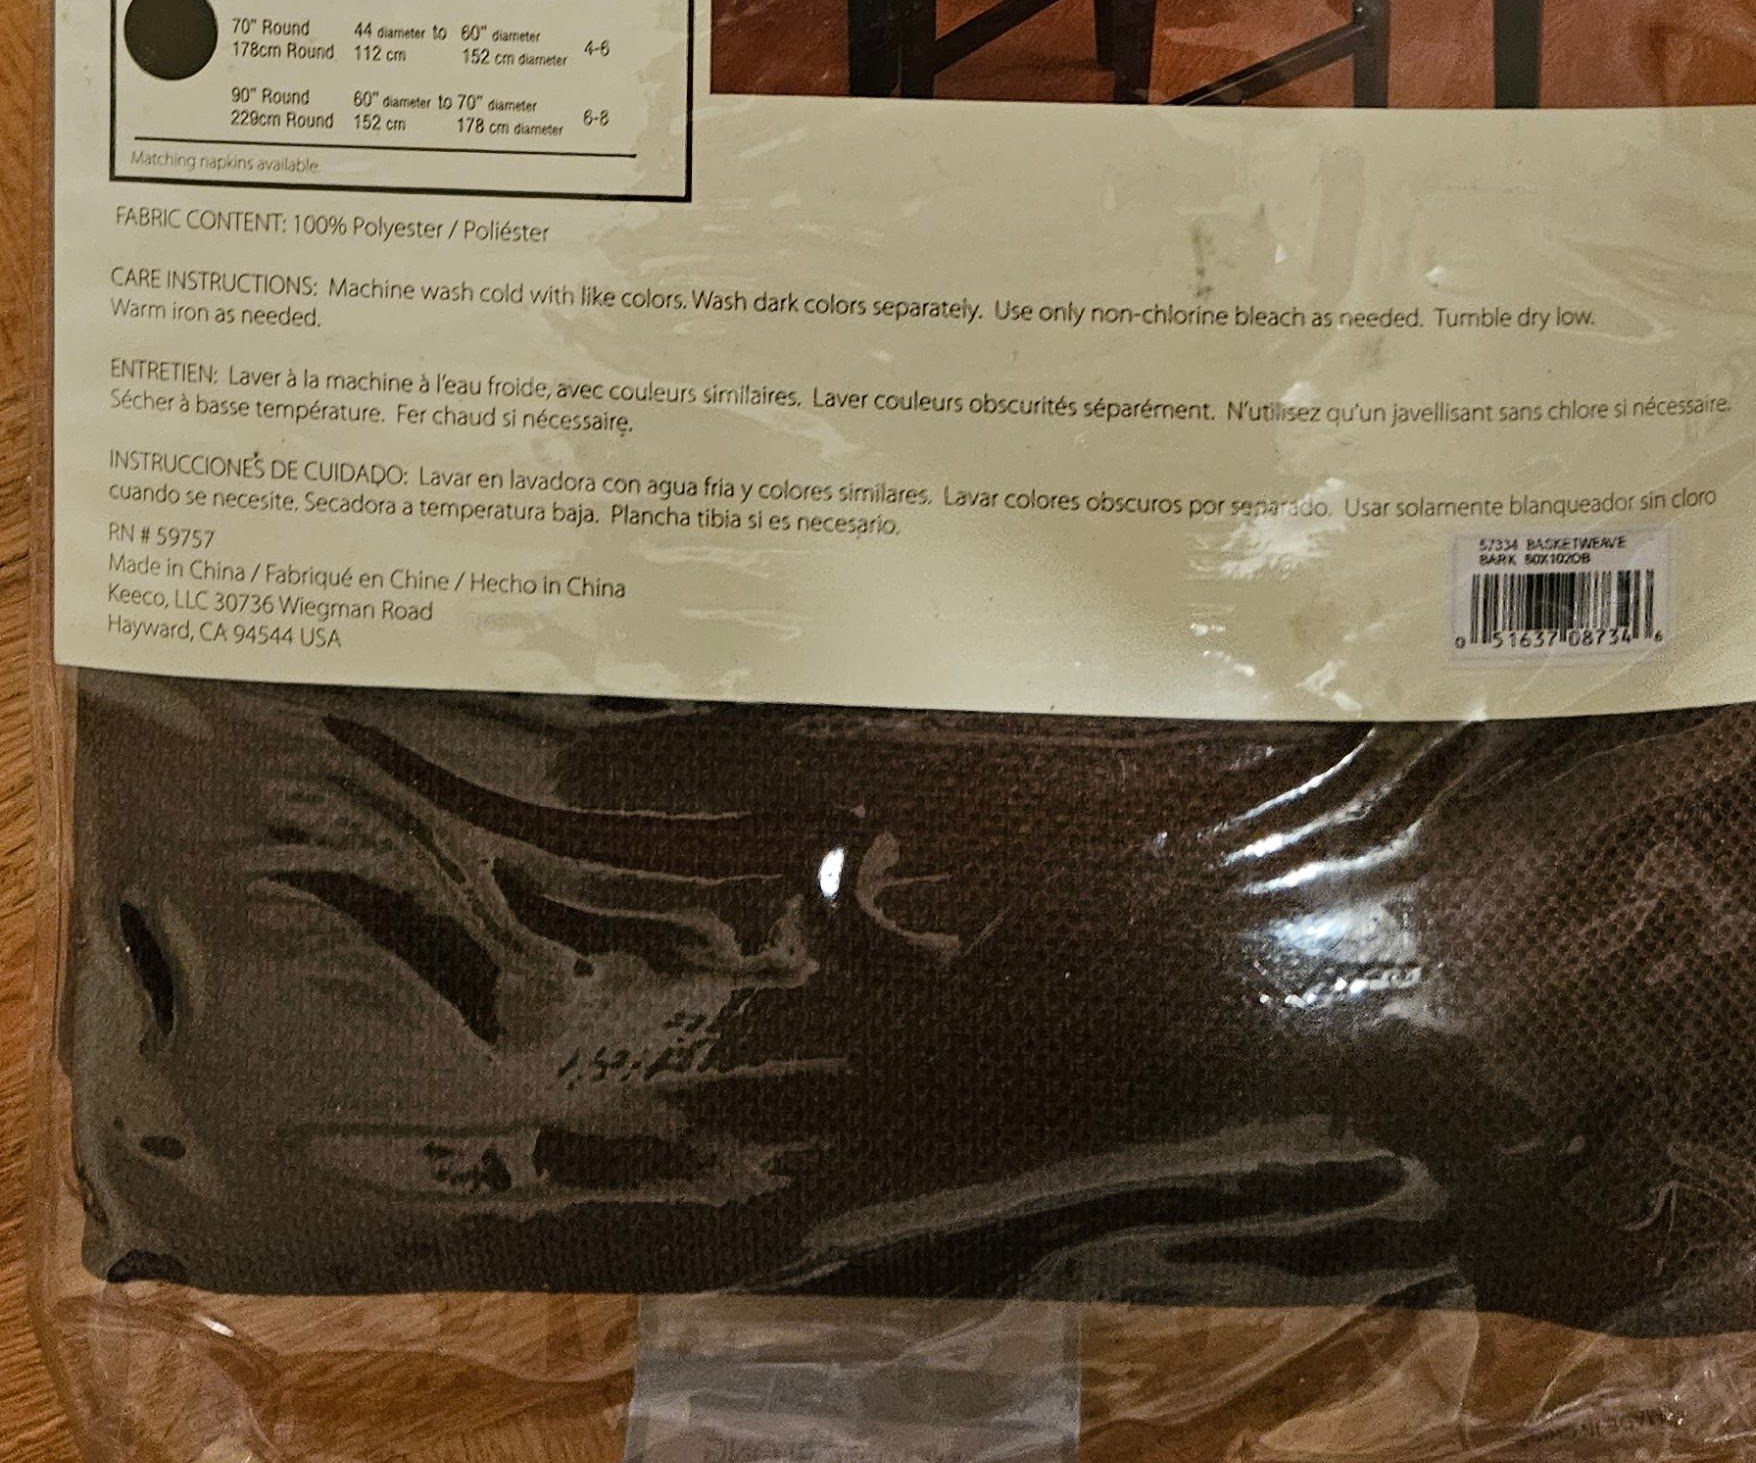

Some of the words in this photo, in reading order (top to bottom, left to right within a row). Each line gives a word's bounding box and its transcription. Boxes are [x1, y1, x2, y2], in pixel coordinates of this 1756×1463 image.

[261, 86, 310, 107] Round
[382, 95, 432, 110] diameter
[437, 94, 453, 112] to
[487, 98, 538, 113] diameter
[582, 108, 610, 128] 6-8
[130, 149, 197, 172] Matching
[199, 154, 254, 172] napkins
[256, 155, 320, 174] available
[116, 204, 181, 229] FABRIC
[186, 208, 287, 234] CONTENT:
[294, 213, 348, 236] 100%
[353, 215, 444, 244] Polyester
[447, 219, 459, 241] /
[463, 218, 550, 244] Poliéster
[110, 265, 161, 290] CARE
[166, 269, 318, 298] INSTRUCTIONS:
[328, 276, 416, 302] Machine
[420, 280, 474, 303] wash
[479, 281, 524, 304] cold
[529, 284, 575, 307] with
[580, 284, 617, 309] like
[620, 287, 688, 311] colors.
[691, 287, 748, 313] Wash
[752, 290, 800, 314] dark
[803, 292, 868, 316] colors
[872, 297, 984, 326] separately.
[994, 299, 1034, 323] Use
[1038, 299, 1086, 328] only
[1090, 302, 1230, 327] non-chlorine
[1234, 303, 1306, 328] bleach
[1310, 310, 1333, 330] as
[1339, 306, 1424, 329] needed.
[1433, 305, 1513, 329] Tumble
[1516, 305, 1551, 332] dry
[1555, 304, 1595, 327] low.
[111, 297, 166, 320] Warm
[172, 300, 209, 323] iron
[214, 306, 236, 325] as
[241, 304, 321, 328] needed.
[110, 356, 218, 385] ENTRETIEN:
[228, 364, 282, 388] Laver
[285, 368, 298, 390] à
[303, 367, 320, 391] la
[325, 371, 414, 395] machine
[418, 372, 431, 394] à
[436, 372, 482, 397] l'eau
[487, 373, 552, 401] froide,
[555, 381, 604, 402] avec
[608, 381, 697, 405] couleurs
[703, 382, 802, 408] similaires.
[812, 385, 869, 411] Laver
[873, 388, 964, 414] couleurs
[968, 392, 1078, 418] obscurités
[1083, 395, 1216, 423] séparément.
[1326, 402, 1386, 428] qu'un
[1390, 400, 1493, 428] javellisant
[1499, 404, 1543, 424] sans
[1547, 399, 1609, 421] chlore
[1613, 398, 1627, 420] si
[1632, 394, 1732, 418] nécessaire.
[110, 388, 175, 412] Sécher
[179, 392, 190, 414] à
[195, 393, 250, 418] basse
[255, 398, 385, 425] température.
[397, 402, 427, 425] Fer
[431, 403, 497, 428] chaud
[502, 408, 517, 429] si
[522, 407, 633, 439] nécessaire.
[270, 458, 298, 482] DE
[303, 460, 408, 488] CUIDADO:
[419, 465, 473, 489] Lavar
[477, 472, 504, 490] en
[509, 467, 596, 493] lavadora
[601, 476, 642, 496] con
[646, 477, 699, 503] agua
[703, 474, 736, 500] fria
[740, 483, 754, 506] y
[757, 478, 833, 503] colores
[943, 485, 1000, 508] Lavar
[1003, 488, 1081, 512] colores
[1085, 489, 1183, 516] obscuros
[1188, 497, 1226, 520] por
[1344, 496, 1391, 519] Usar
[1395, 496, 1504, 519] solamente
[1509, 490, 1635, 518] blanqueador
[1640, 490, 1667, 512] sin
[1670, 487, 1717, 510] cloro
[108, 482, 181, 506] cuando
[185, 488, 208, 507] se
[212, 489, 299, 512] necesite.
[304, 489, 397, 517] Secadora
[401, 499, 414, 517] a
[419, 499, 546, 523] temperatura
[552, 500, 600, 530] baja.
[610, 502, 691, 528] Plancha
[696, 506, 742, 530] tibia
[747, 509, 763, 531] si
[768, 513, 792, 533] es
[796, 513, 900, 540] necesario.
[108, 520, 135, 543] RN
[140, 526, 151, 545] #
[156, 525, 215, 550] 59757
[109, 552, 161, 576] Made
[167, 558, 184, 578] in
[189, 558, 246, 583] China
[250, 562, 262, 583] /
[265, 562, 354, 591] Fabriqué
[358, 572, 384, 590] en
[389, 568, 450, 592] Chine
[454, 570, 466, 593] /
[470, 571, 538, 596] Hecho
[542, 573, 562, 596] in
[566, 574, 626, 600] China
[108, 582, 169, 610] Keeco,
[175, 588, 208, 612] LLC
[214, 591, 275, 616] 30736
[278, 594, 376, 623] Wiegman
[381, 598, 434, 623] Road
[108, 613, 195, 643] Hayward,
[199, 620, 228, 643] CA
[233, 622, 294, 646] 94544
[300, 626, 342, 649] USA
[1491, 629, 1560, 649] 51637
[1567, 626, 1633, 648] 08734
